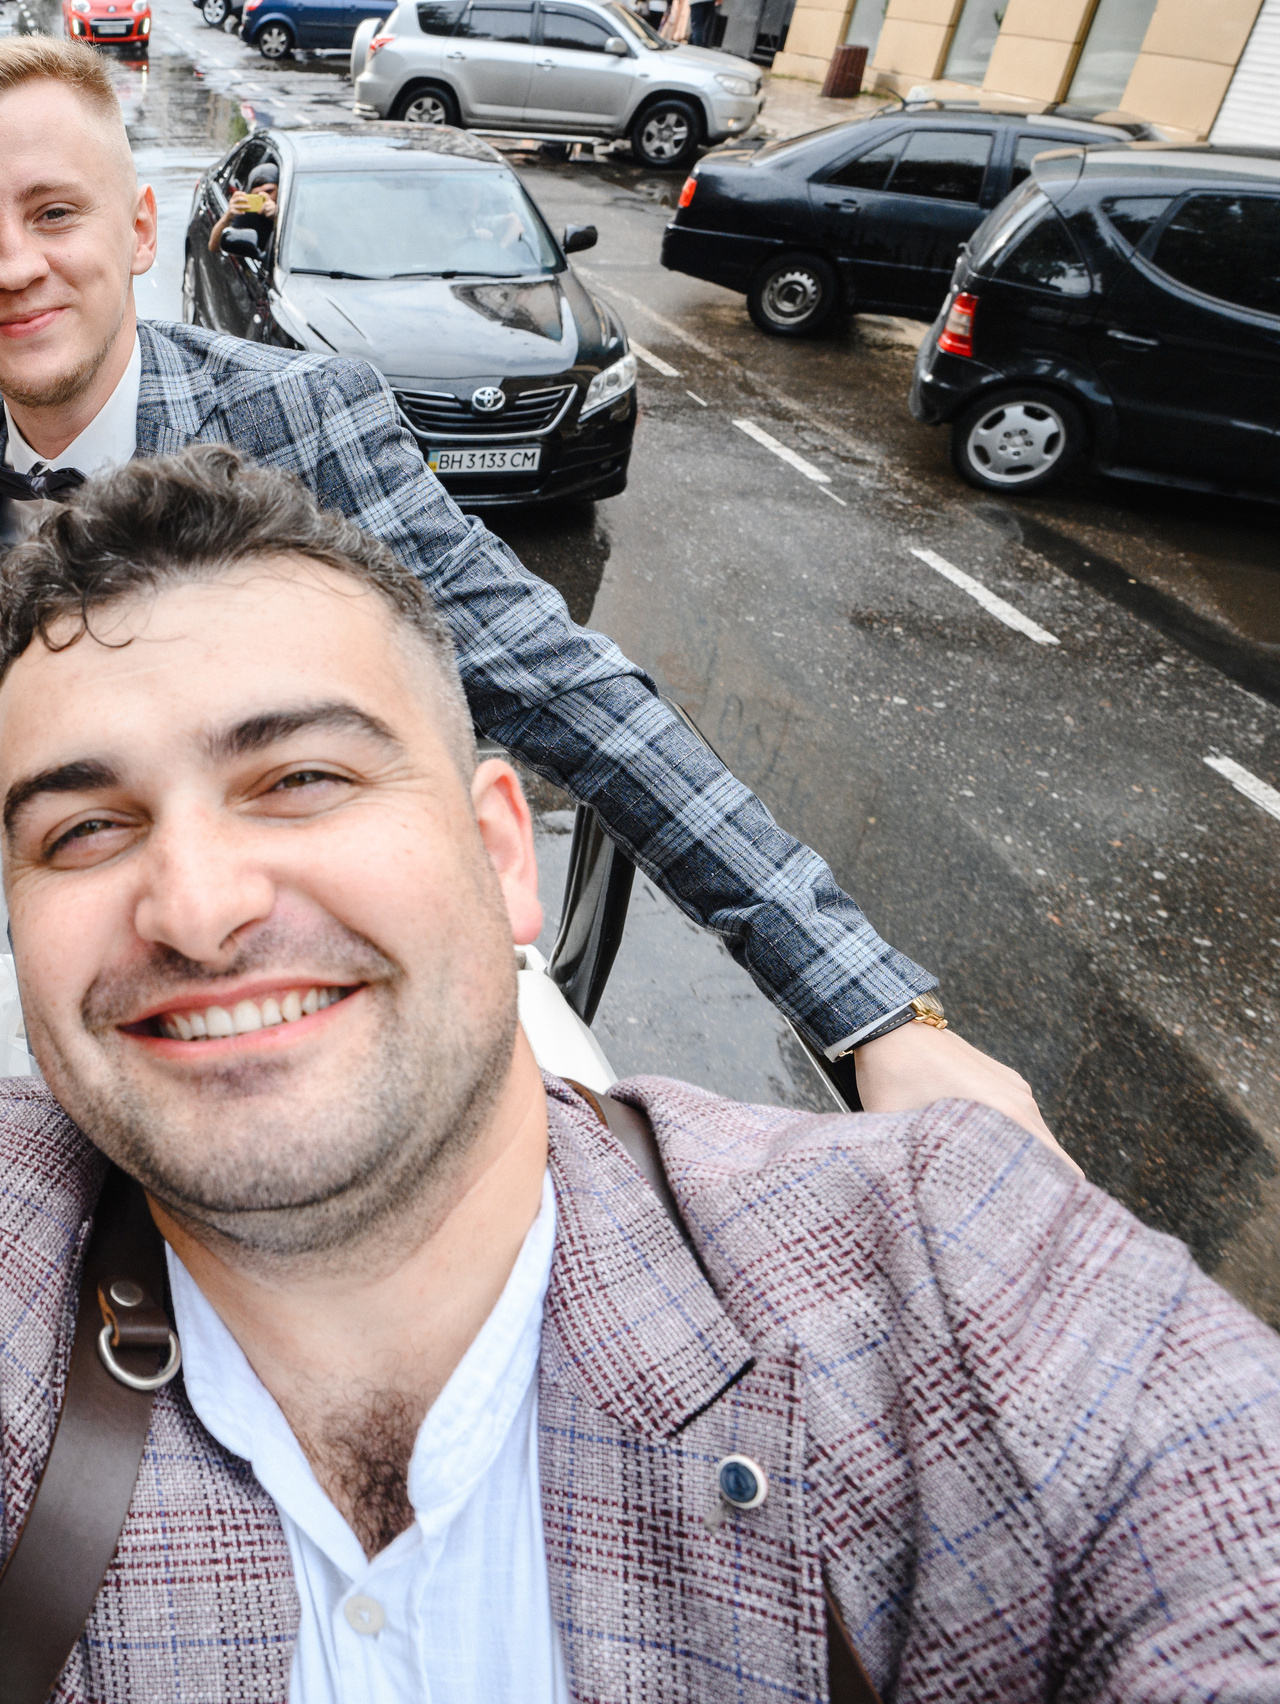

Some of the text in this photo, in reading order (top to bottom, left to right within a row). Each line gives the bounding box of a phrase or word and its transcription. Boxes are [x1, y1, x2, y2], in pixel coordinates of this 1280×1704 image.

[438, 451, 537, 470] BH 3133 CM
